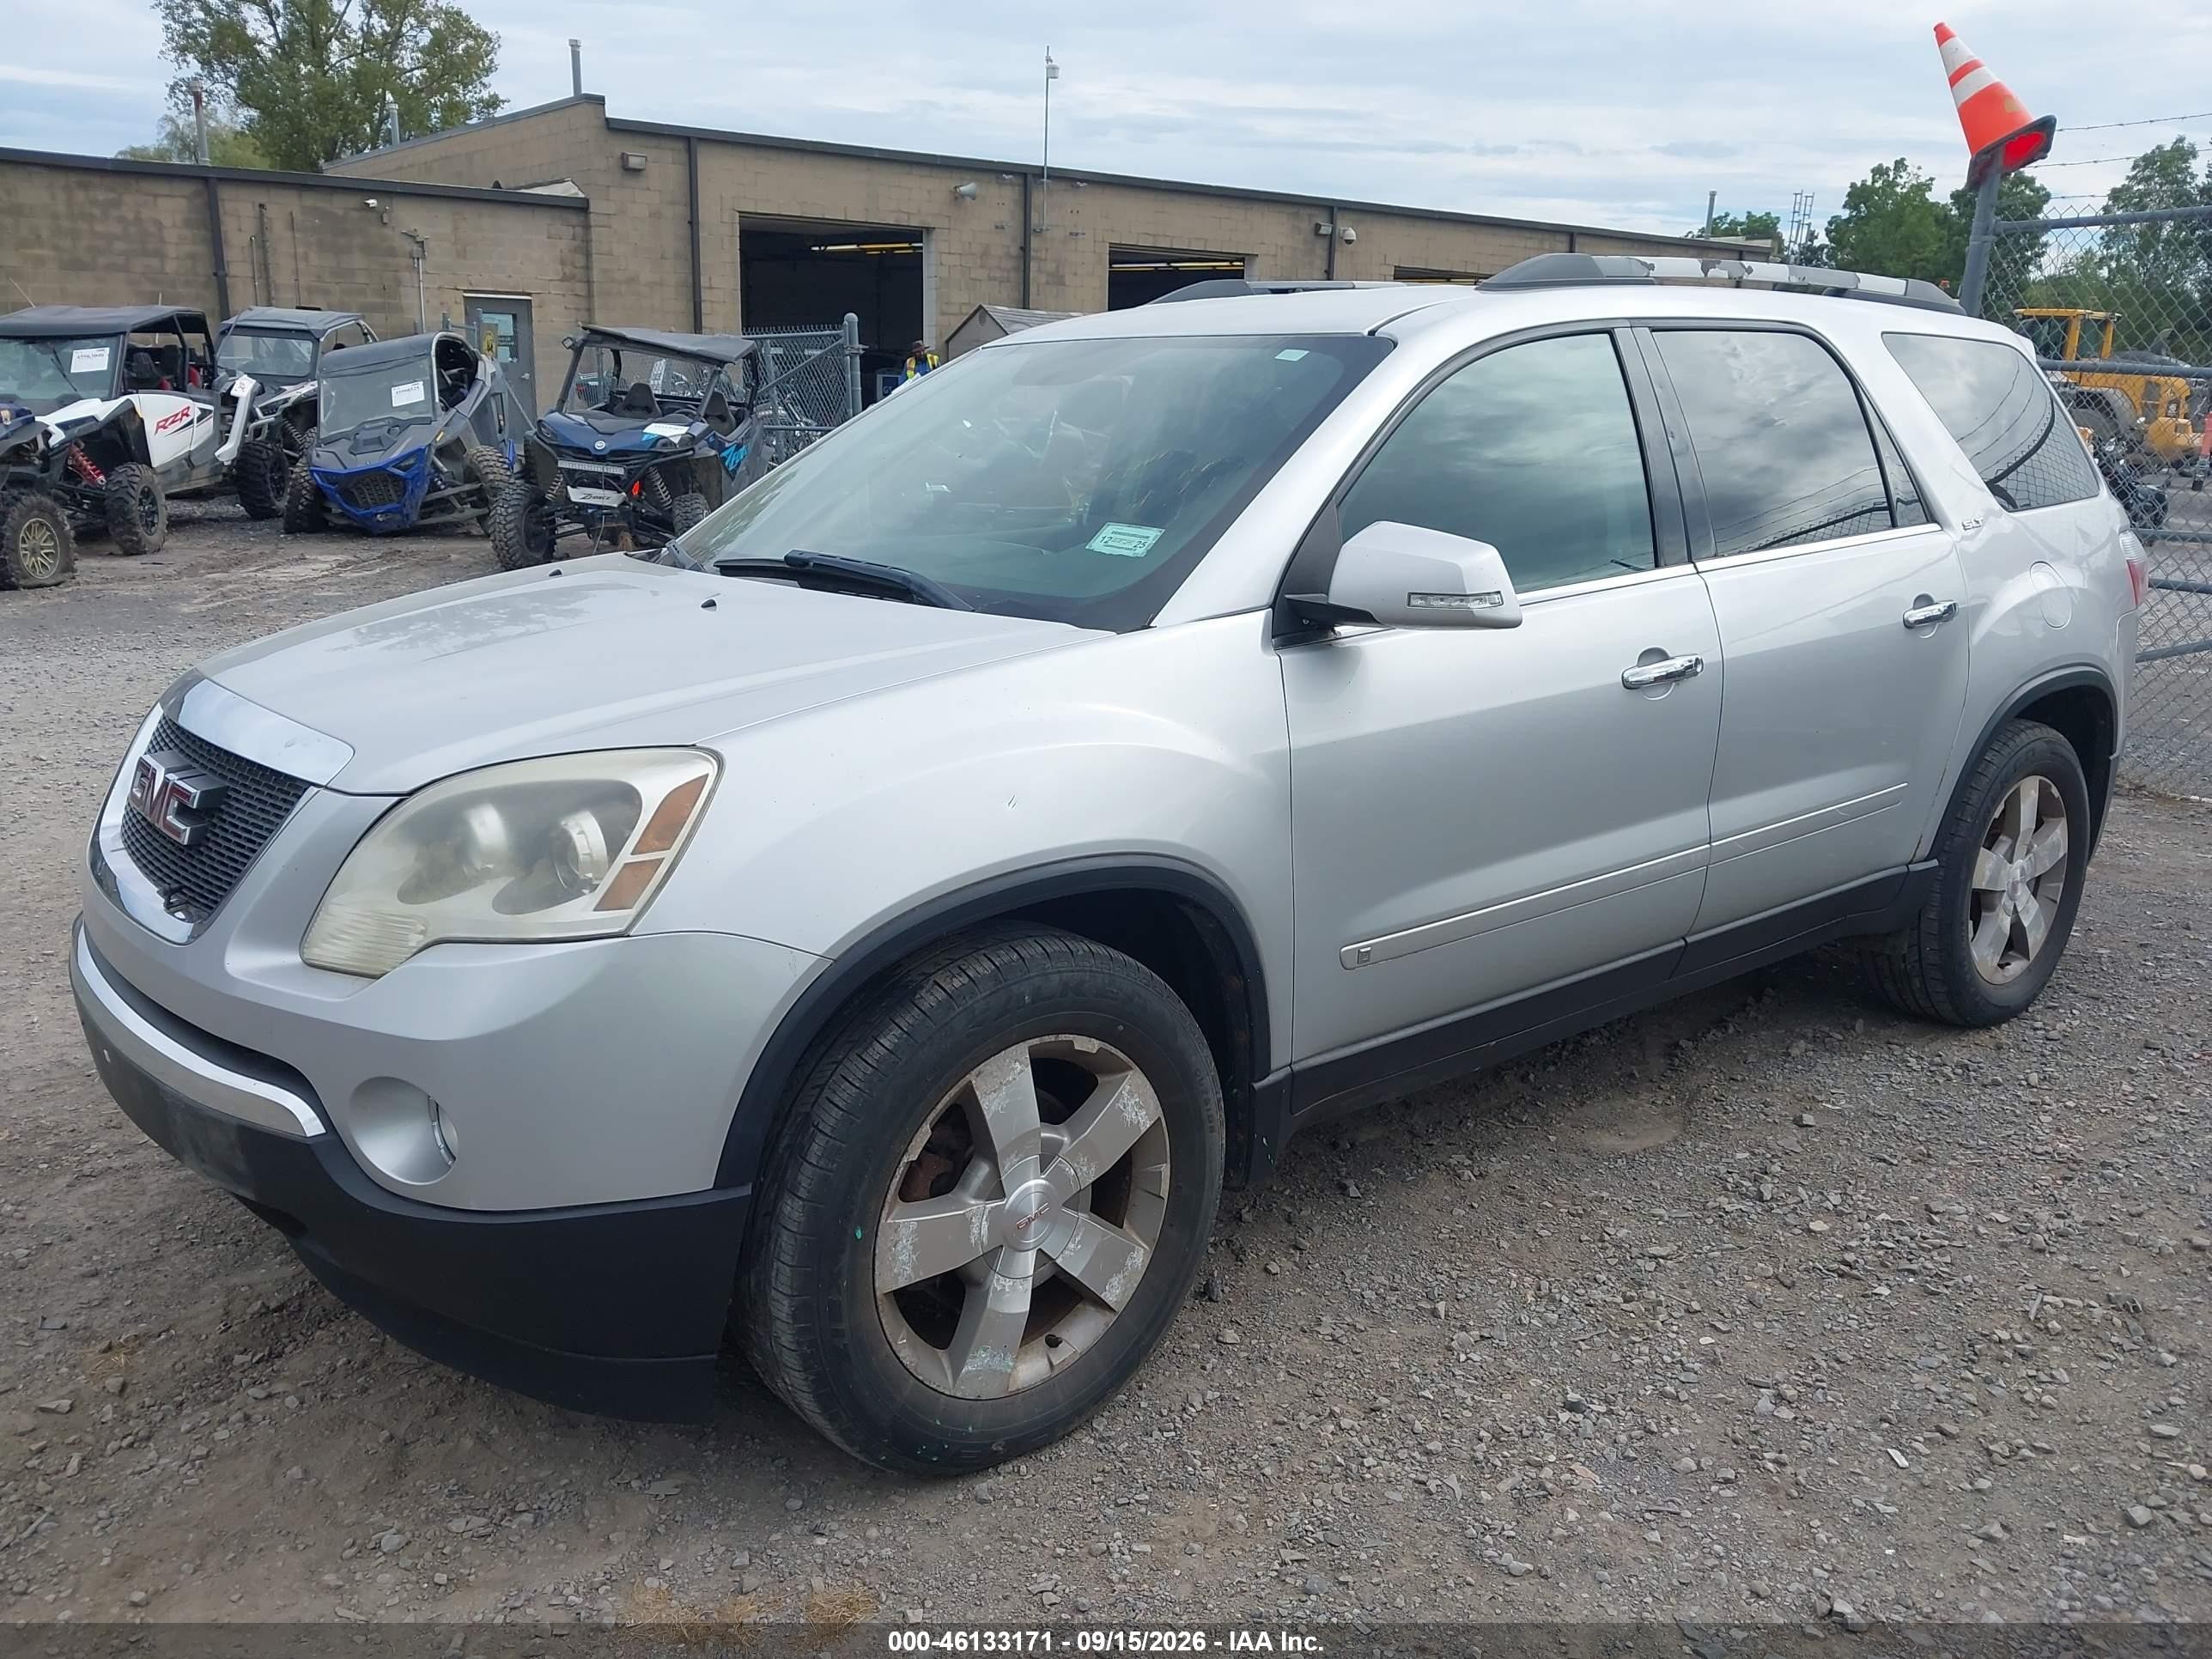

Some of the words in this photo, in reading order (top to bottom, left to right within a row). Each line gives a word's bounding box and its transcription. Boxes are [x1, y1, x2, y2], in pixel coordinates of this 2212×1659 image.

[154, 405, 191, 435] RZR
[1961, 517, 1984, 532] SLT
[1099, 535, 1113, 544] 12
[1133, 540, 1147, 549] 25
[129, 755, 201, 846] GMC
[1017, 1202, 1050, 1229] GMC
